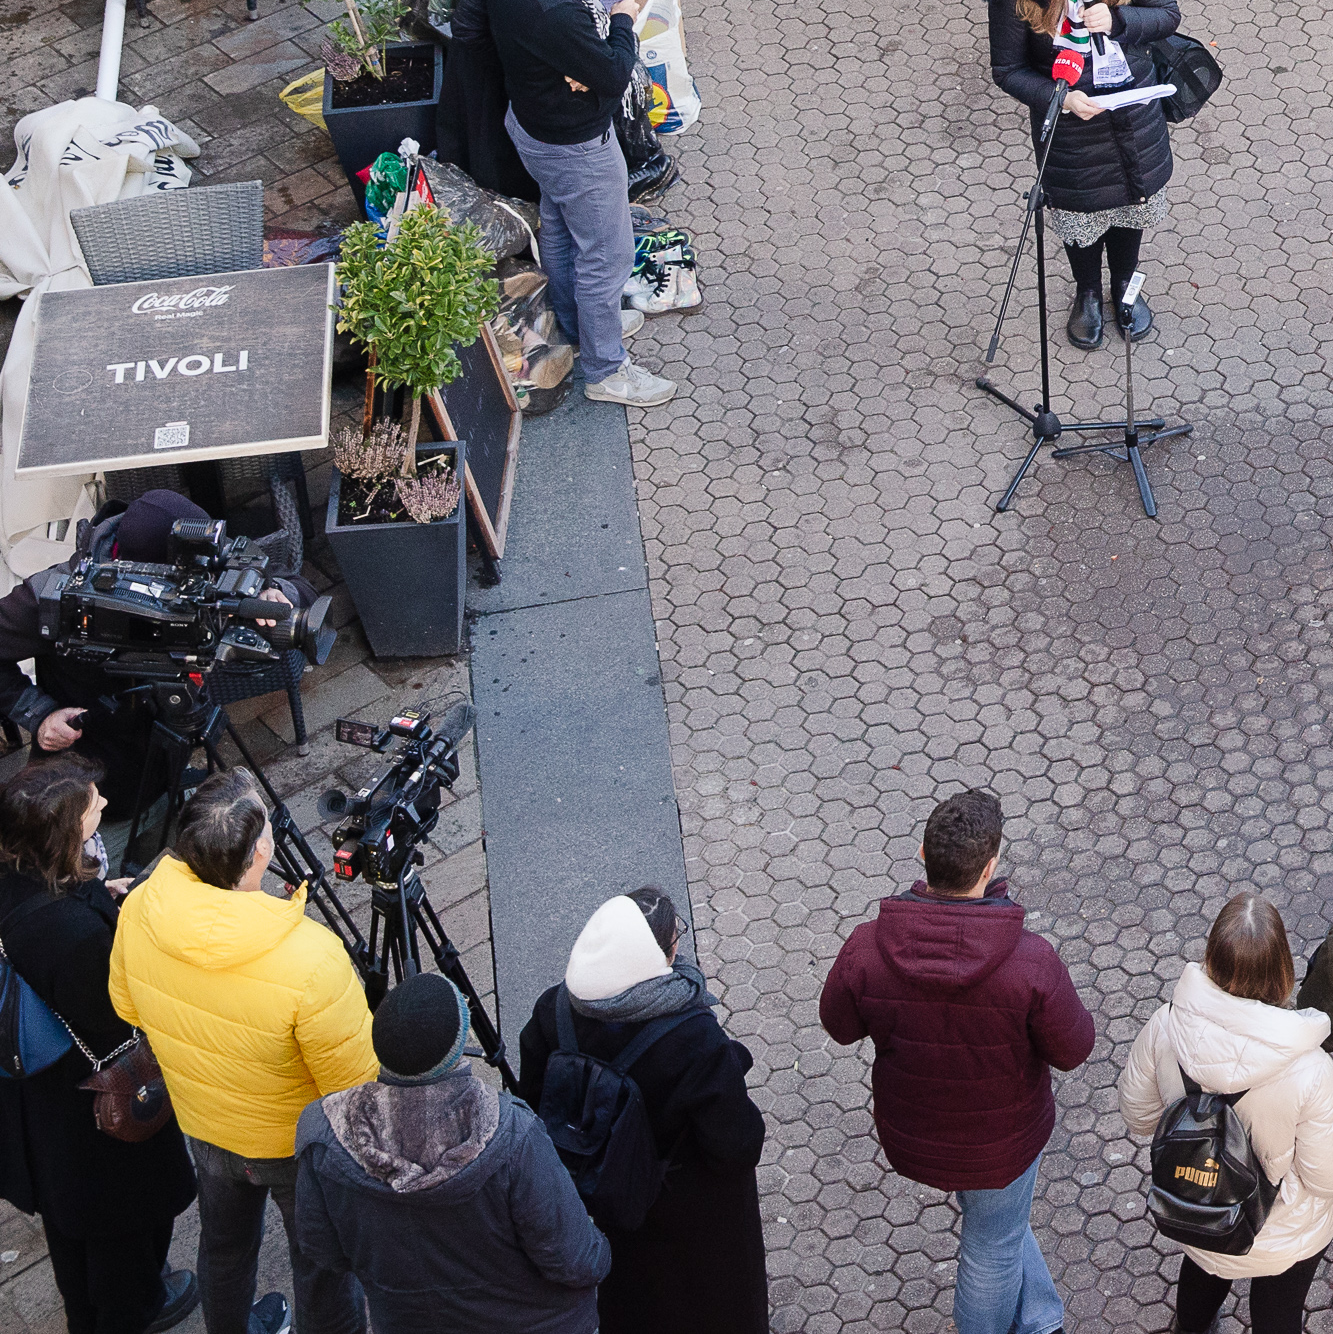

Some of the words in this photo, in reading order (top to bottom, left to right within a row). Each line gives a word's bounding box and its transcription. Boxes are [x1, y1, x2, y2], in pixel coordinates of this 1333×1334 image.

[132, 284, 236, 314] Coca-Cola
[177, 310, 204, 318] Magic
[106, 350, 249, 384] TIVOLI
[1174, 1165, 1219, 1187] PUMA
